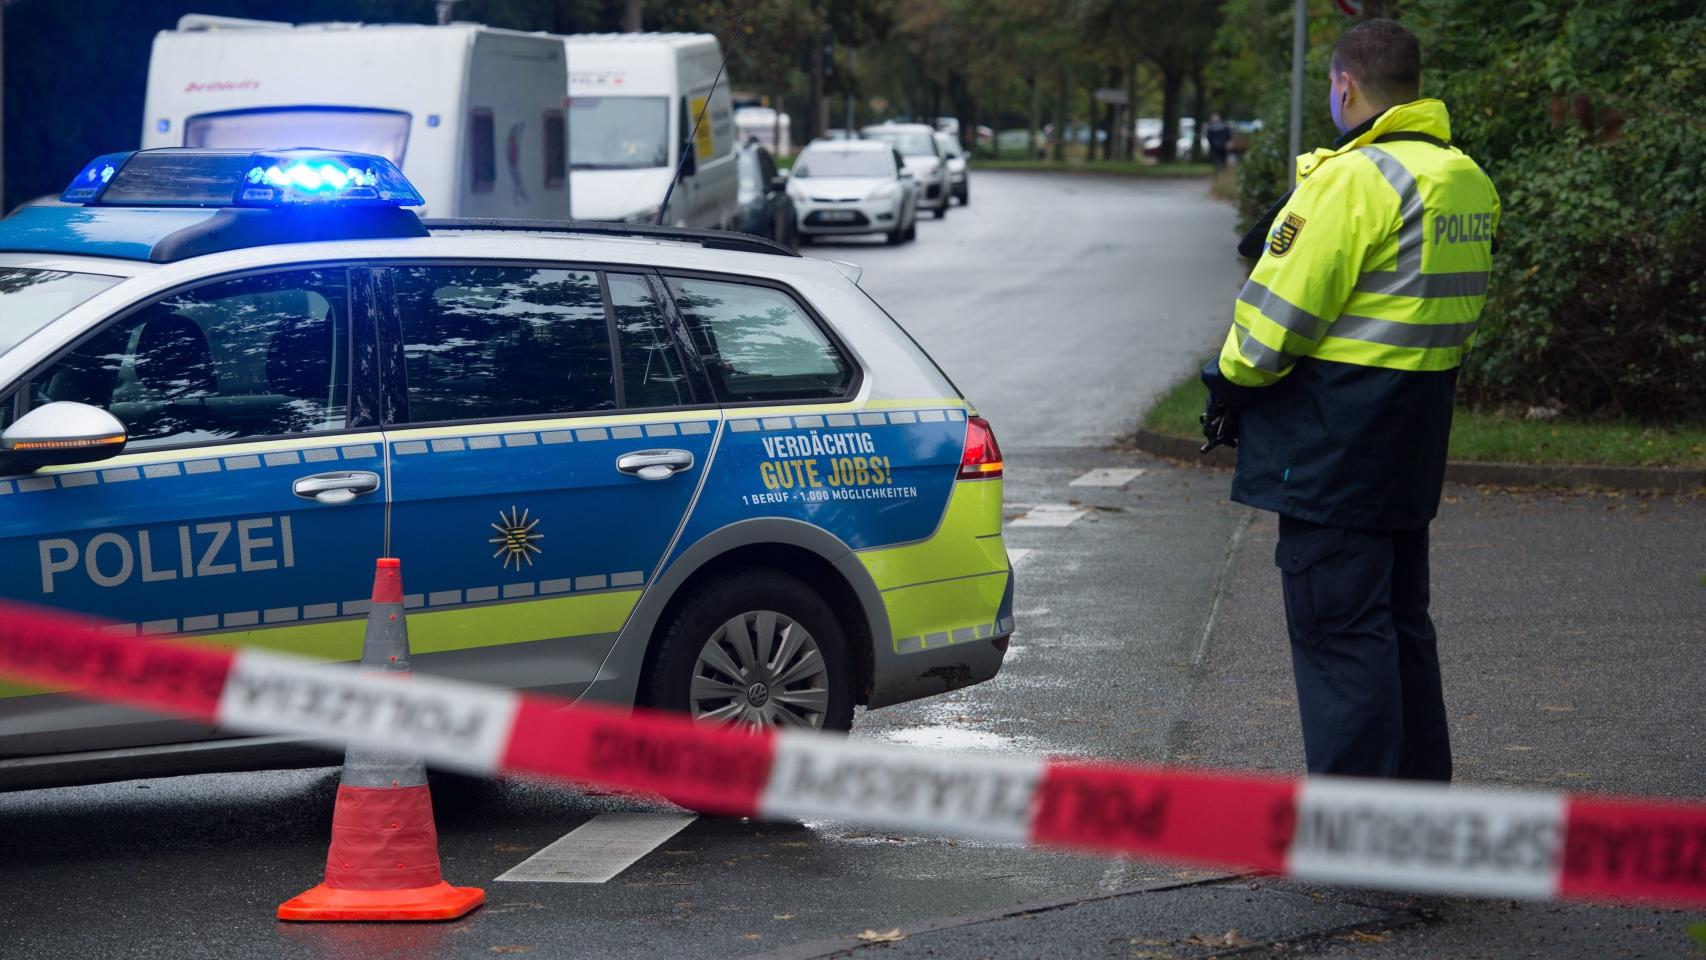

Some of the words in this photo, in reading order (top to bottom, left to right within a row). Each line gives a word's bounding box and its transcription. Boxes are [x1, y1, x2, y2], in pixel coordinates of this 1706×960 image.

[1435, 213, 1491, 245] POLIZE
[762, 431, 874, 457] VERDÄCHTIG
[760, 458, 822, 490] GUTE
[828, 456, 893, 486] JOBS!
[742, 495, 749, 505] 1
[752, 492, 789, 505] BERUF
[800, 490, 829, 501] 1.000
[833, 486, 917, 500] MÖGLICHKEITEN
[38, 516, 295, 593] POLIZEI
